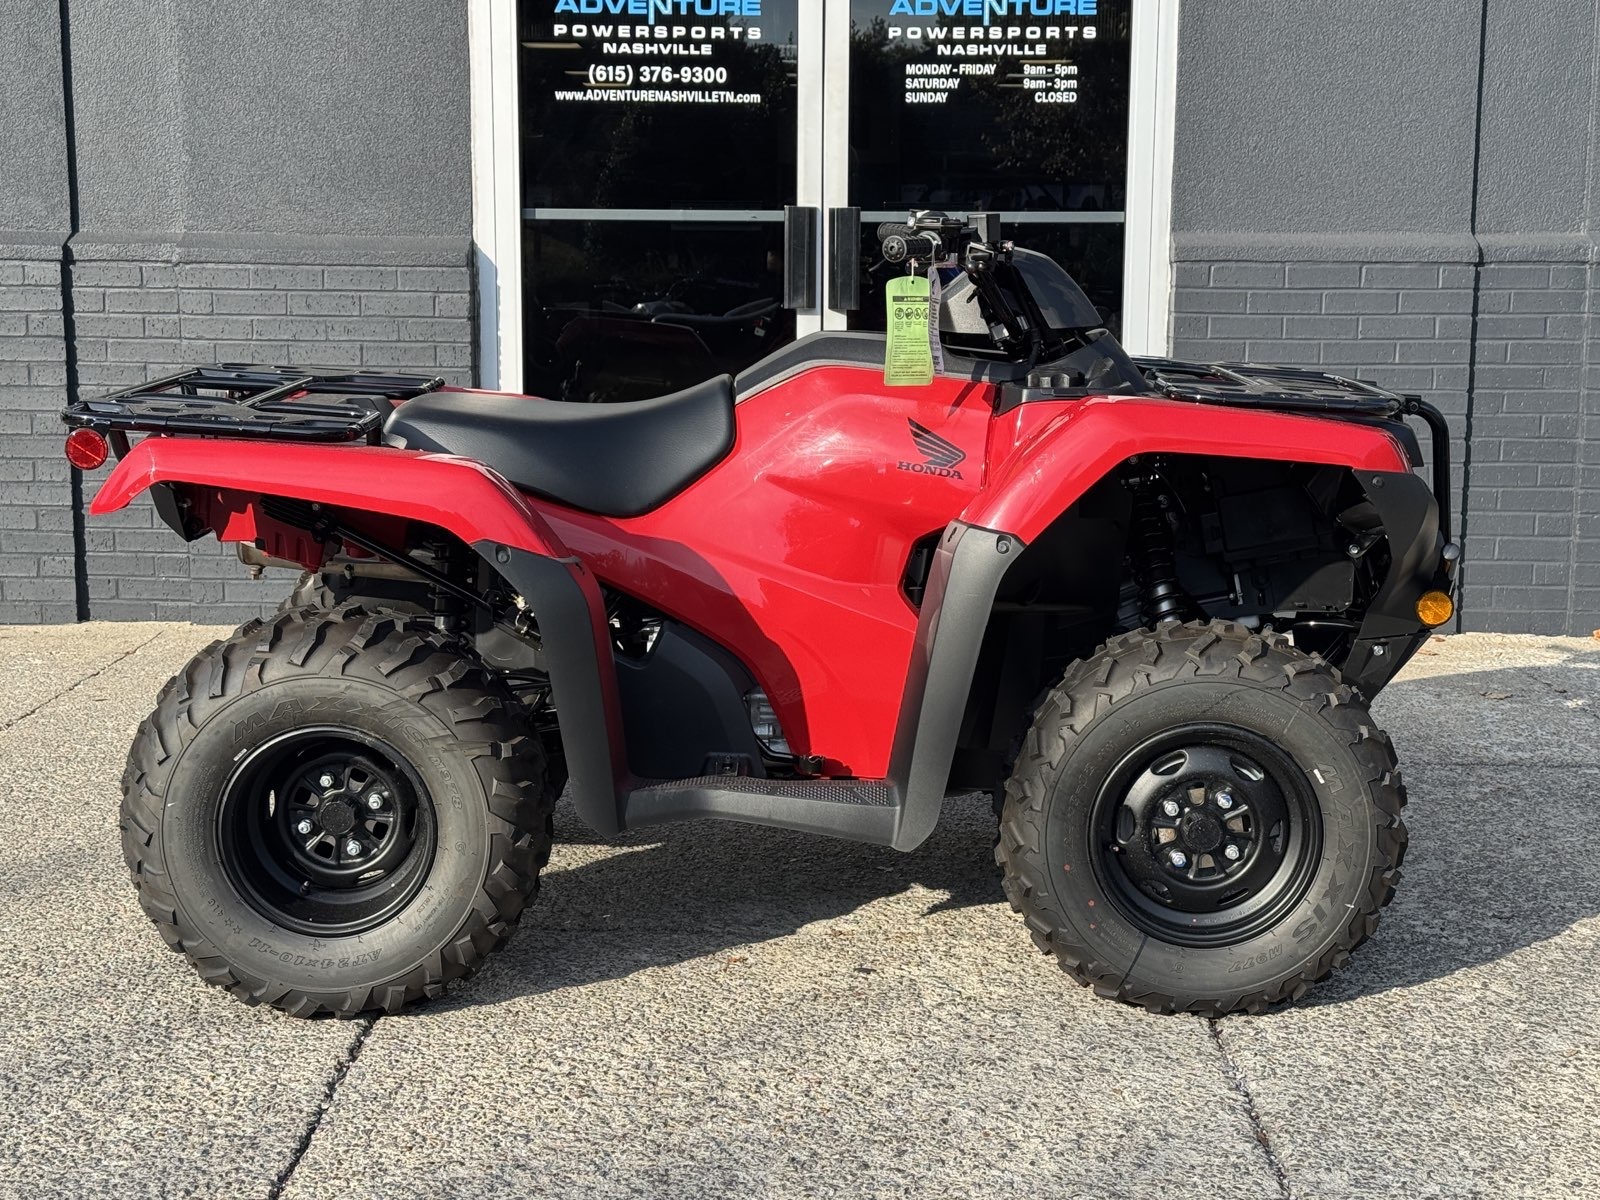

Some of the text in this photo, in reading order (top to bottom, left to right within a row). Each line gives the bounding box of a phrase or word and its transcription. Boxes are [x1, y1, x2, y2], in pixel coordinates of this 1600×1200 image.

[554, 0, 762, 24] ADVENTURE
[889, 0, 1097, 25] ADVENTURE
[553, 24, 762, 39] POWERSPORTS
[888, 26, 1097, 39] POWERSPORTS
[603, 42, 713, 55] NASHVILLE
[937, 44, 1047, 56] NASHVILLE
[588, 64, 727, 84] (615) 376-9300
[905, 78, 960, 89] SATURDAY
[555, 89, 761, 103] www.ADVENTURENASHVILLETN.com
[905, 91, 1077, 103] SUNDAY CLOSED
[897, 460, 964, 480] HONDA
[234, 696, 430, 750] MAXXIS
[427, 755, 463, 810] M978
[1292, 762, 1354, 944] MAXXIS
[1228, 943, 1284, 973] M977
